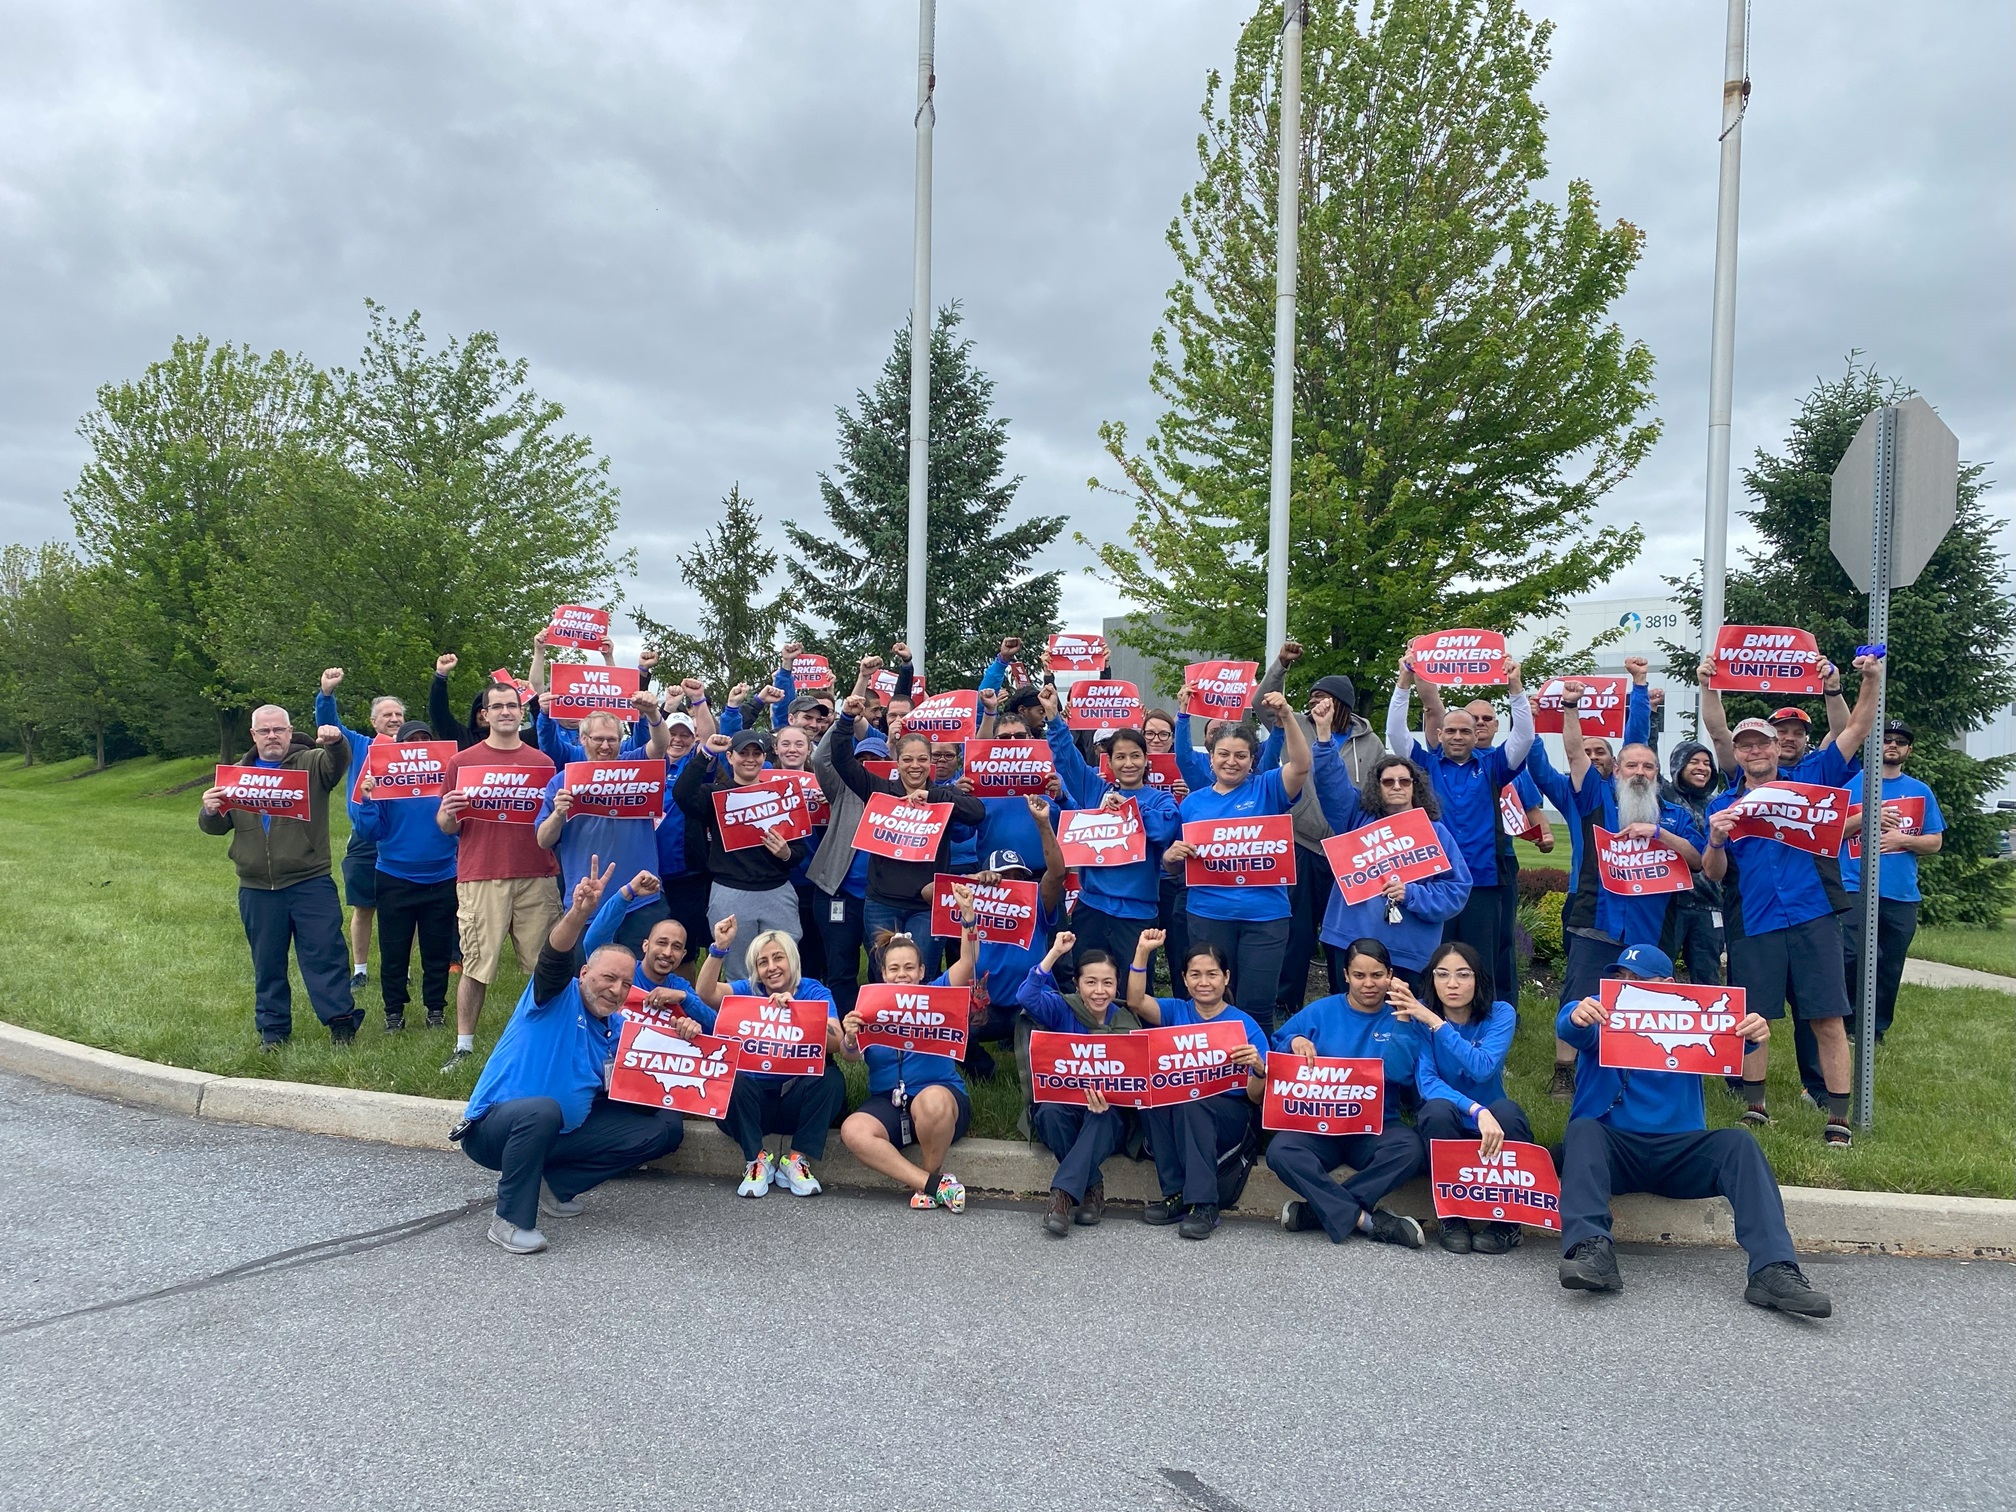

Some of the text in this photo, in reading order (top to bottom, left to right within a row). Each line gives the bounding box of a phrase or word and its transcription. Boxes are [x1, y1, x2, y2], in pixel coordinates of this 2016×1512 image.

[563, 610, 594, 622] BMW
[1646, 614, 1676, 628] 3819
[550, 618, 606, 634] WORKERS
[554, 629, 598, 641] UNITED
[1436, 635, 1482, 648] BMW
[1743, 634, 1796, 647] BMW
[1051, 646, 1102, 655] STAND UP
[1416, 648, 1502, 661] WORKERS
[1719, 648, 1818, 663] WORKERS
[1217, 668, 1243, 680] BMW
[1426, 662, 1491, 674] UNITED
[1730, 664, 1803, 678] UNITED
[583, 671, 609, 682] WE
[569, 683, 622, 696] STAND
[874, 682, 896, 691] STA
[1088, 686, 1124, 696] BMW
[1198, 679, 1248, 694] WORKERS
[919, 697, 956, 708] BMW
[1072, 698, 1140, 708] WORKERS
[1204, 692, 1242, 708] UNITED
[1596, 696, 1619, 708] UP
[1079, 709, 1130, 718] UNITED
[906, 719, 962, 731] UNITED
[400, 748, 427, 760] WE
[989, 747, 1033, 759] BMW
[388, 761, 441, 774] STAND
[970, 759, 1053, 773] WORKERS
[239, 774, 283, 787] BMW
[374, 772, 445, 786] TOGETHE
[482, 772, 530, 786] BMW
[592, 768, 640, 782] BMW
[980, 774, 1042, 786] UNITED
[222, 786, 304, 800] WORKERS
[463, 786, 546, 799] WORKERS
[572, 781, 660, 796] WORKERS
[230, 799, 293, 808] UNITED
[471, 799, 536, 811] UNITED
[581, 795, 648, 806] UNITED
[724, 802, 779, 825] STAND
[781, 795, 800, 811] UP
[891, 805, 934, 821] BMW
[1733, 802, 1838, 824] STAND UP
[868, 812, 942, 835] WORKERS
[873, 828, 929, 847] UNITED
[1063, 820, 1138, 843] STAND UP
[1213, 825, 1263, 842] BMW
[1360, 826, 1394, 848] WE
[1194, 840, 1288, 858] WORKERS
[1352, 835, 1415, 868] STAND
[1610, 838, 1650, 853] BMW
[1204, 857, 1276, 872] UNITED
[1601, 849, 1678, 866] WORKERS
[1340, 844, 1441, 888] TOGETHER
[1608, 864, 1670, 881] UNITED
[941, 894, 1032, 918] WRKERS
[950, 909, 1018, 930] UITED
[896, 993, 929, 1009] WE
[759, 1005, 792, 1023] WE
[877, 1010, 945, 1026] STAND
[1610, 1013, 1736, 1032] STAND UP
[738, 1020, 804, 1042] STAND
[858, 1023, 964, 1043] TOGETHER
[716, 1034, 822, 1058] GETHER
[1172, 1033, 1208, 1051] WE
[1071, 1043, 1106, 1059] WE
[623, 1052, 729, 1078] STAND UP
[1158, 1049, 1227, 1070] STAND
[1054, 1059, 1125, 1076] STAND
[1296, 1065, 1353, 1082] BMW
[1036, 1073, 1148, 1092] TOGETHER
[1151, 1064, 1247, 1088] OGETHER
[1273, 1080, 1378, 1100] WORKERS
[1284, 1099, 1362, 1117] UNITED
[1478, 1150, 1517, 1167] WE
[1459, 1168, 1535, 1187] STAND
[1437, 1183, 1558, 1211] TOGETHER
